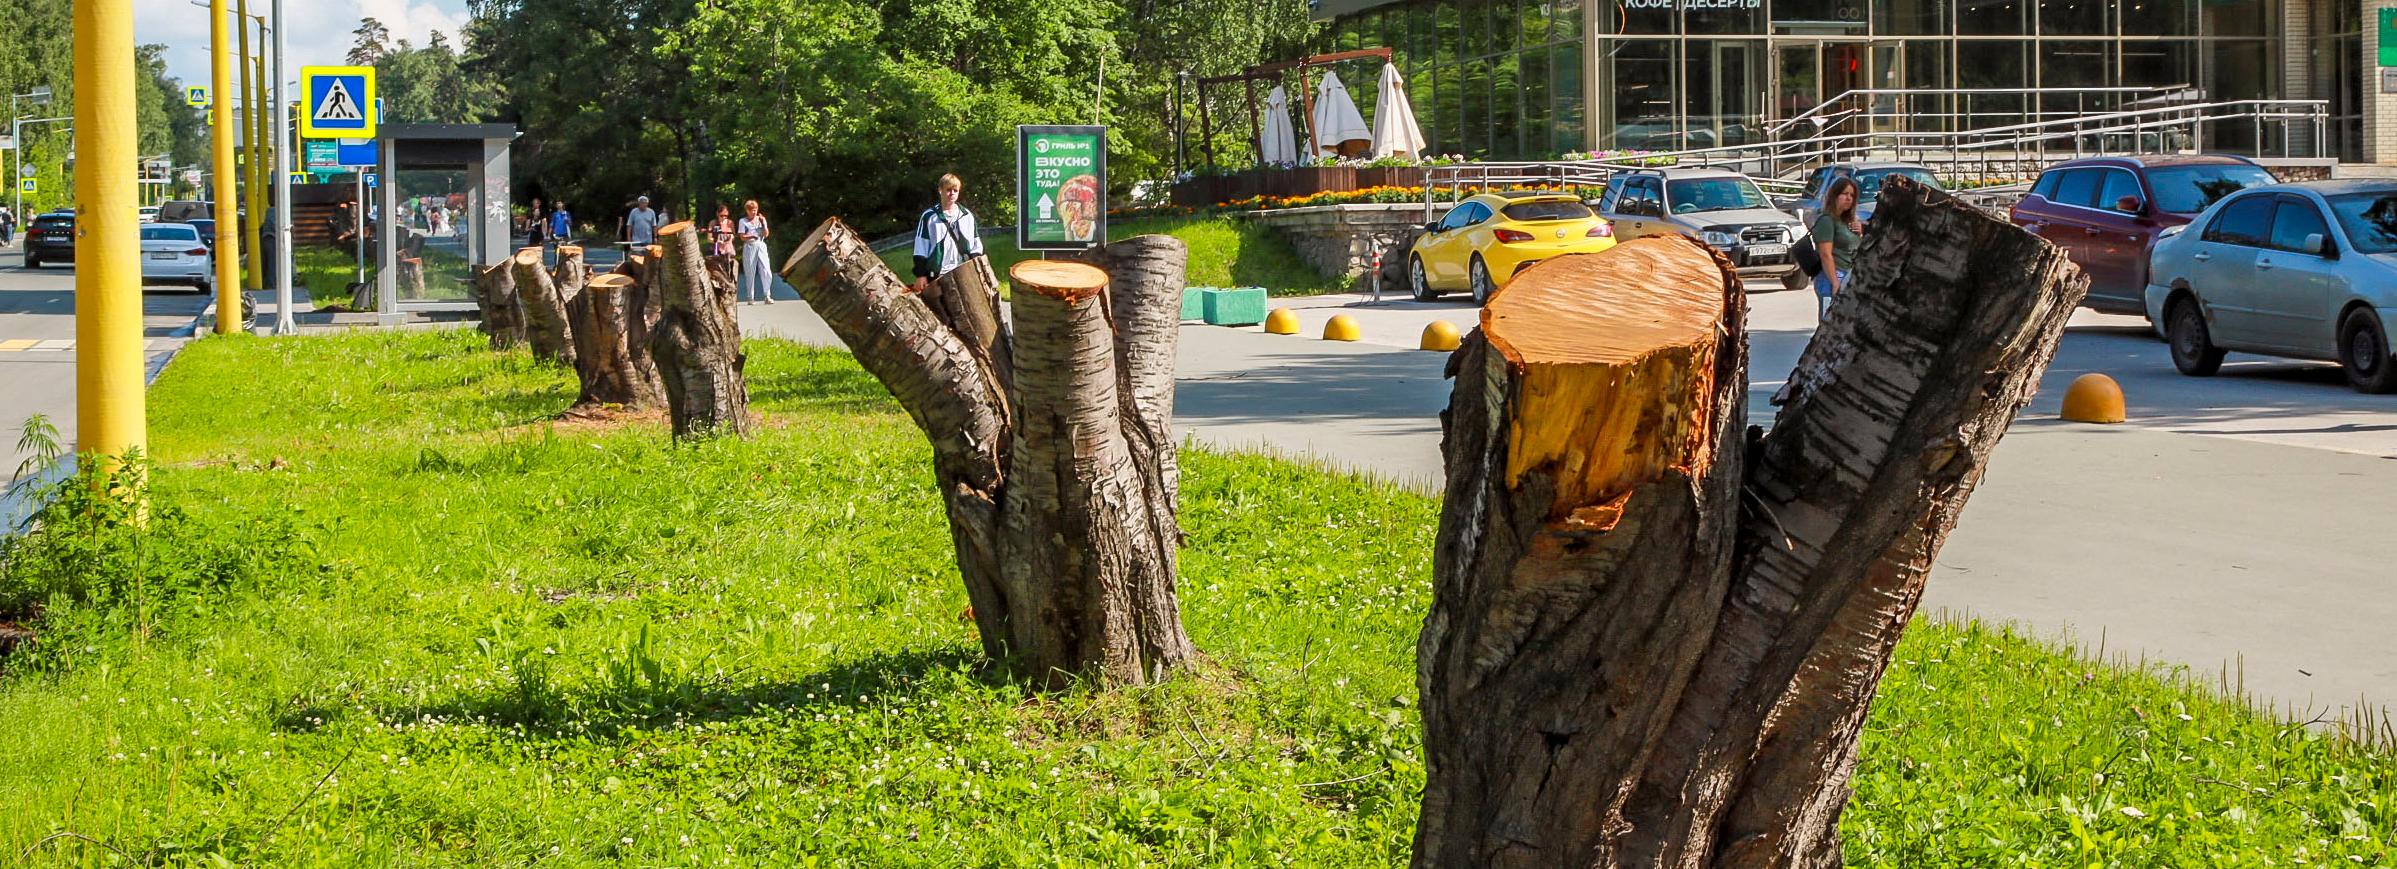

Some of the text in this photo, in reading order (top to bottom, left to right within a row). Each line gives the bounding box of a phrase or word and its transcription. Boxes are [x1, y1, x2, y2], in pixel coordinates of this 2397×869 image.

[1625, 0, 1672, 8] КОФЕ
[1036, 157, 1090, 166] ВКУСНО
[1036, 169, 1060, 178] ЭТО
[1035, 180, 1060, 188] ТУДА!
